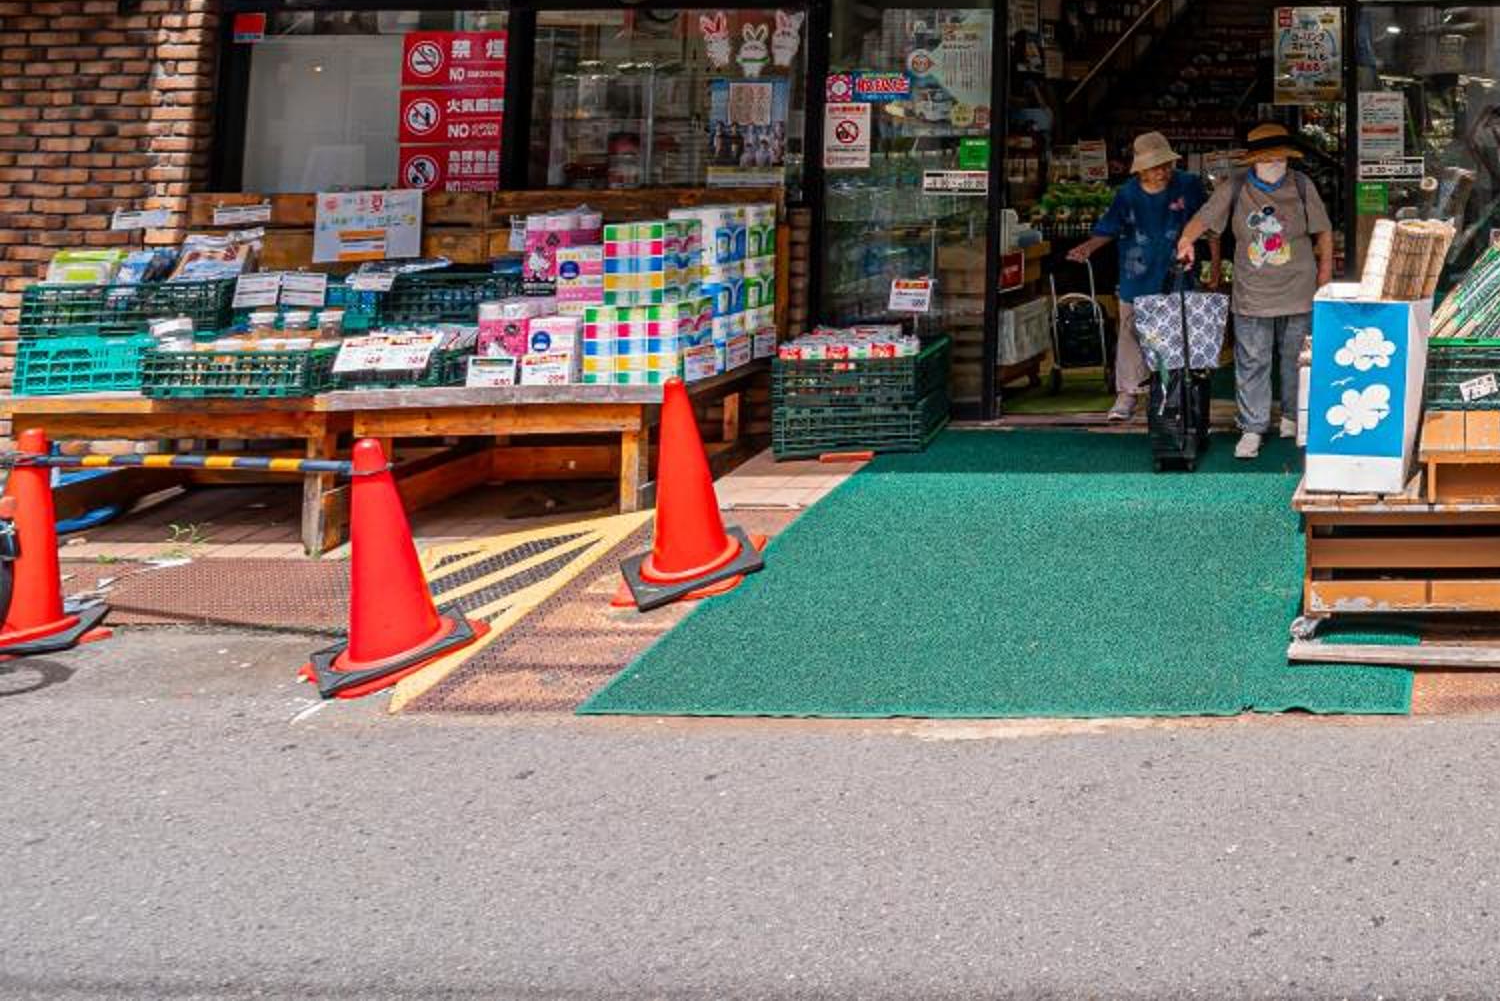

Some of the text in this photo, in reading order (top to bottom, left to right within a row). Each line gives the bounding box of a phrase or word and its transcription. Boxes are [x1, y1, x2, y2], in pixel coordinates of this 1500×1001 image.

[451, 38, 507, 59] 禁煙
[449, 68, 465, 81] NO
[448, 124, 469, 138] NO
